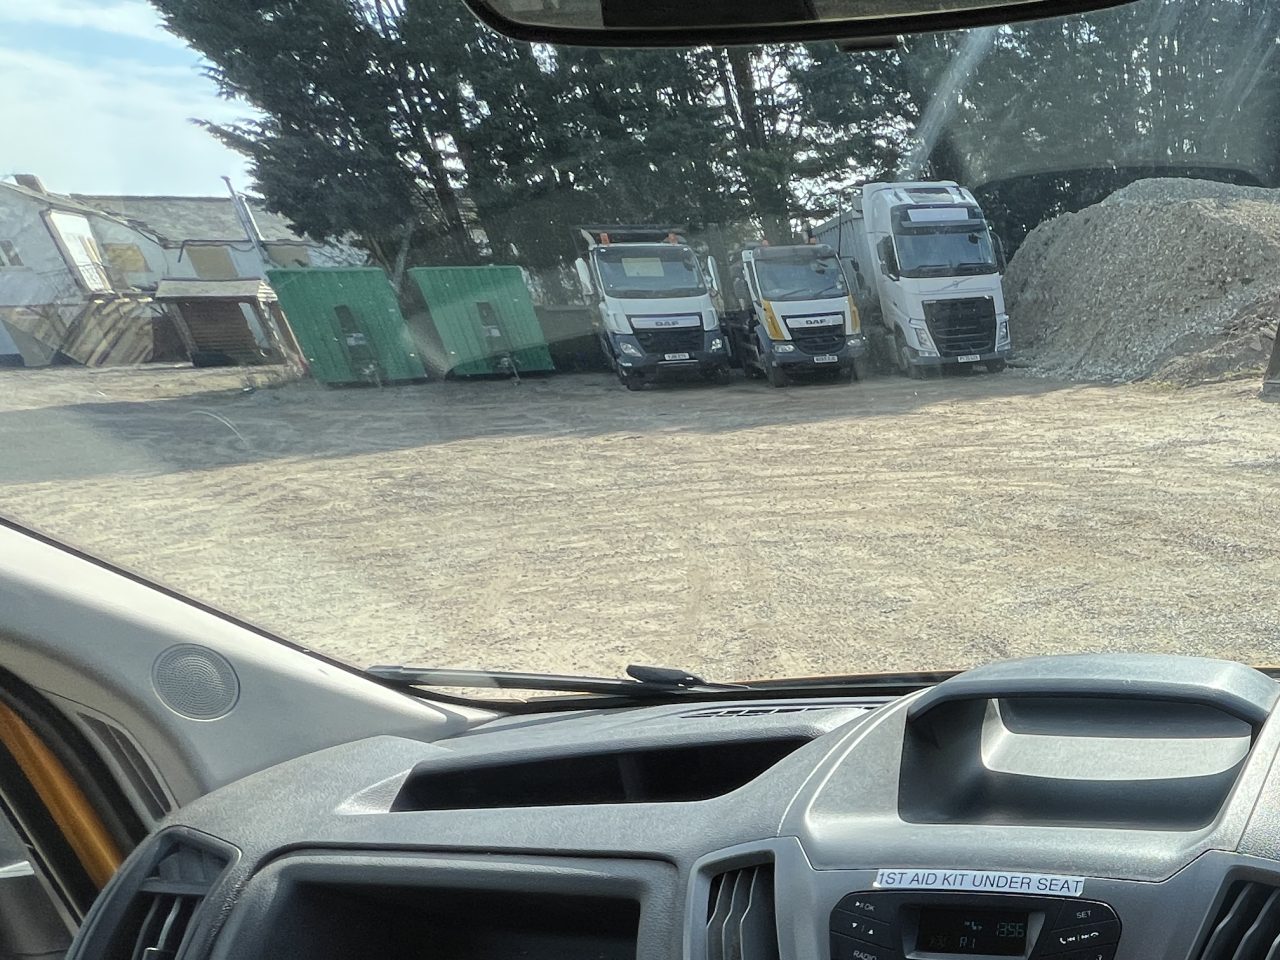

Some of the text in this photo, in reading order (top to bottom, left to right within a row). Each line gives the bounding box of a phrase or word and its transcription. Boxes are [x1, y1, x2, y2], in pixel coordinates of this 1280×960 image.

[879, 872, 1083, 893] 1ST AID KIT UNDER SEAT
[1076, 910, 1091, 919] SET
